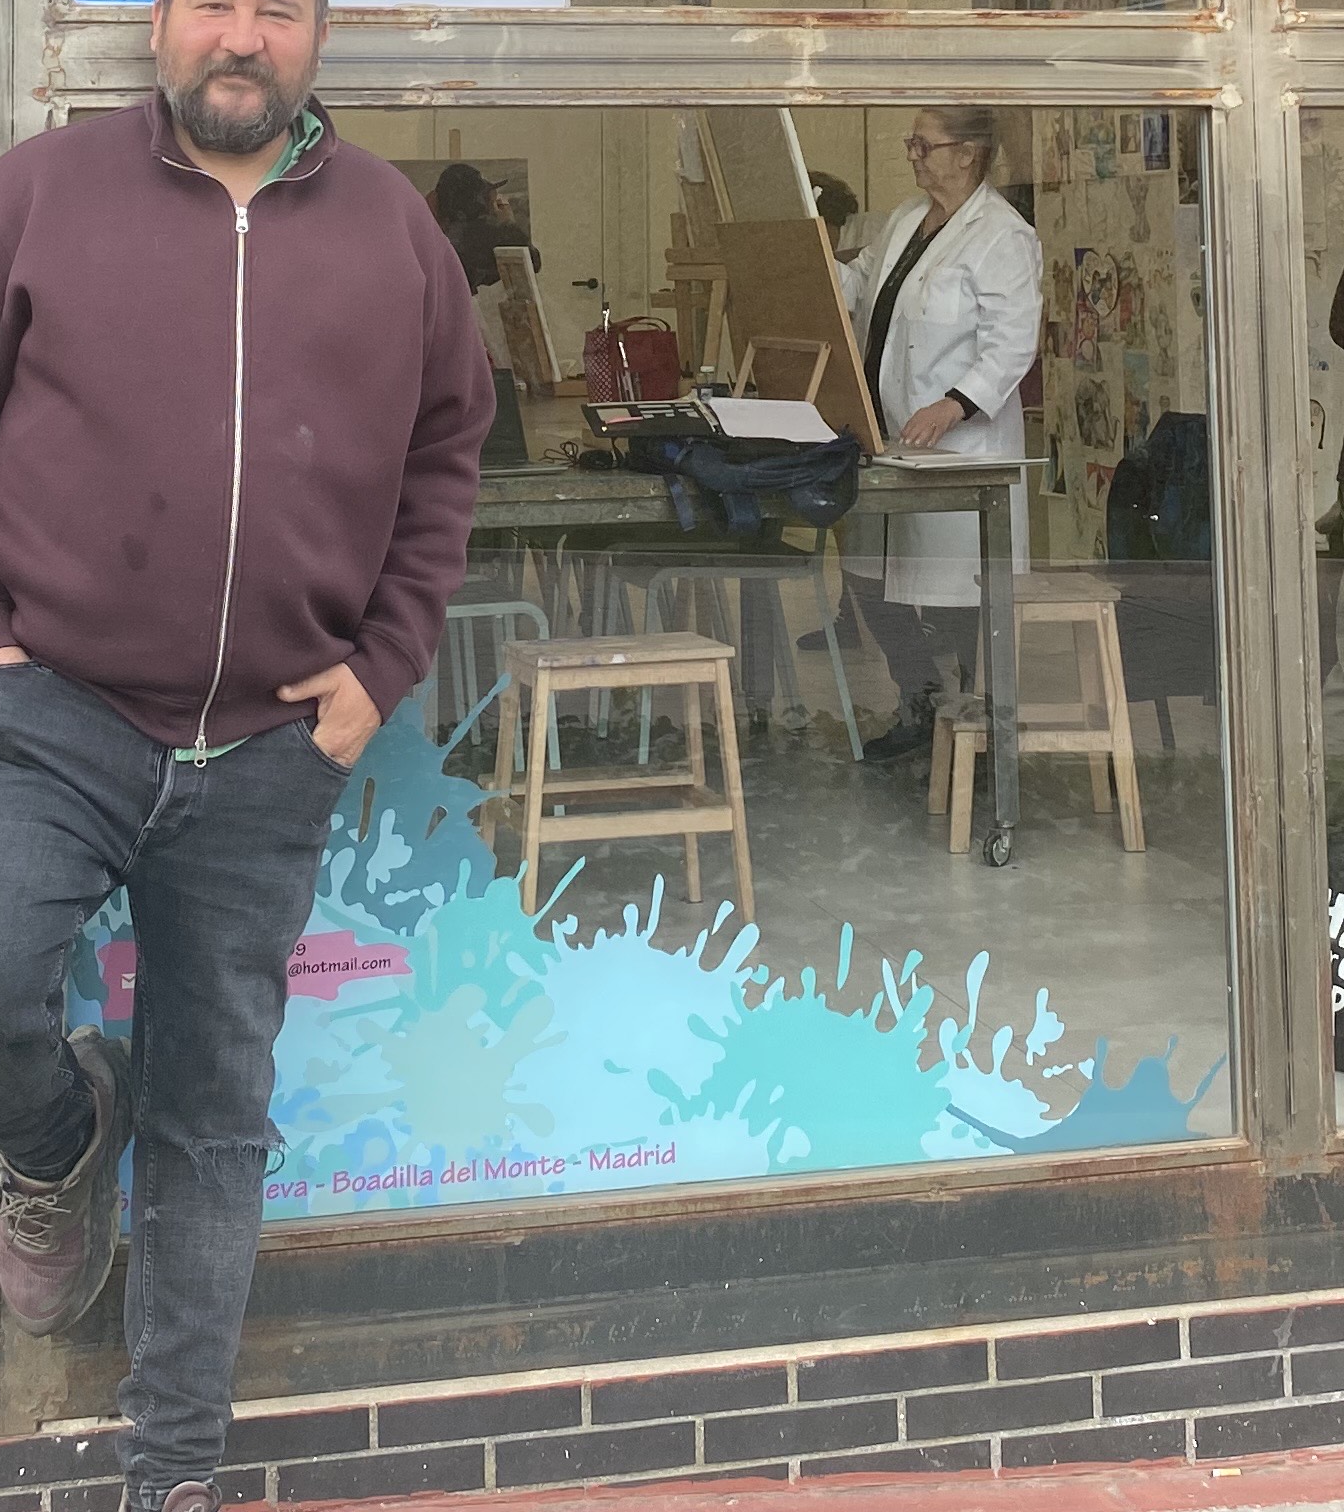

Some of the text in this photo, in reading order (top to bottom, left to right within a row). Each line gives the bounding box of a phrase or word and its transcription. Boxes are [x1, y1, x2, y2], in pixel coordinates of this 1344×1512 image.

[287, 956, 392, 978] @hotmail.com
[332, 1163, 434, 1195] Boadilla
[439, 1159, 478, 1186] del
[484, 1155, 566, 1181] Monte
[588, 1141, 677, 1172] Madrid
